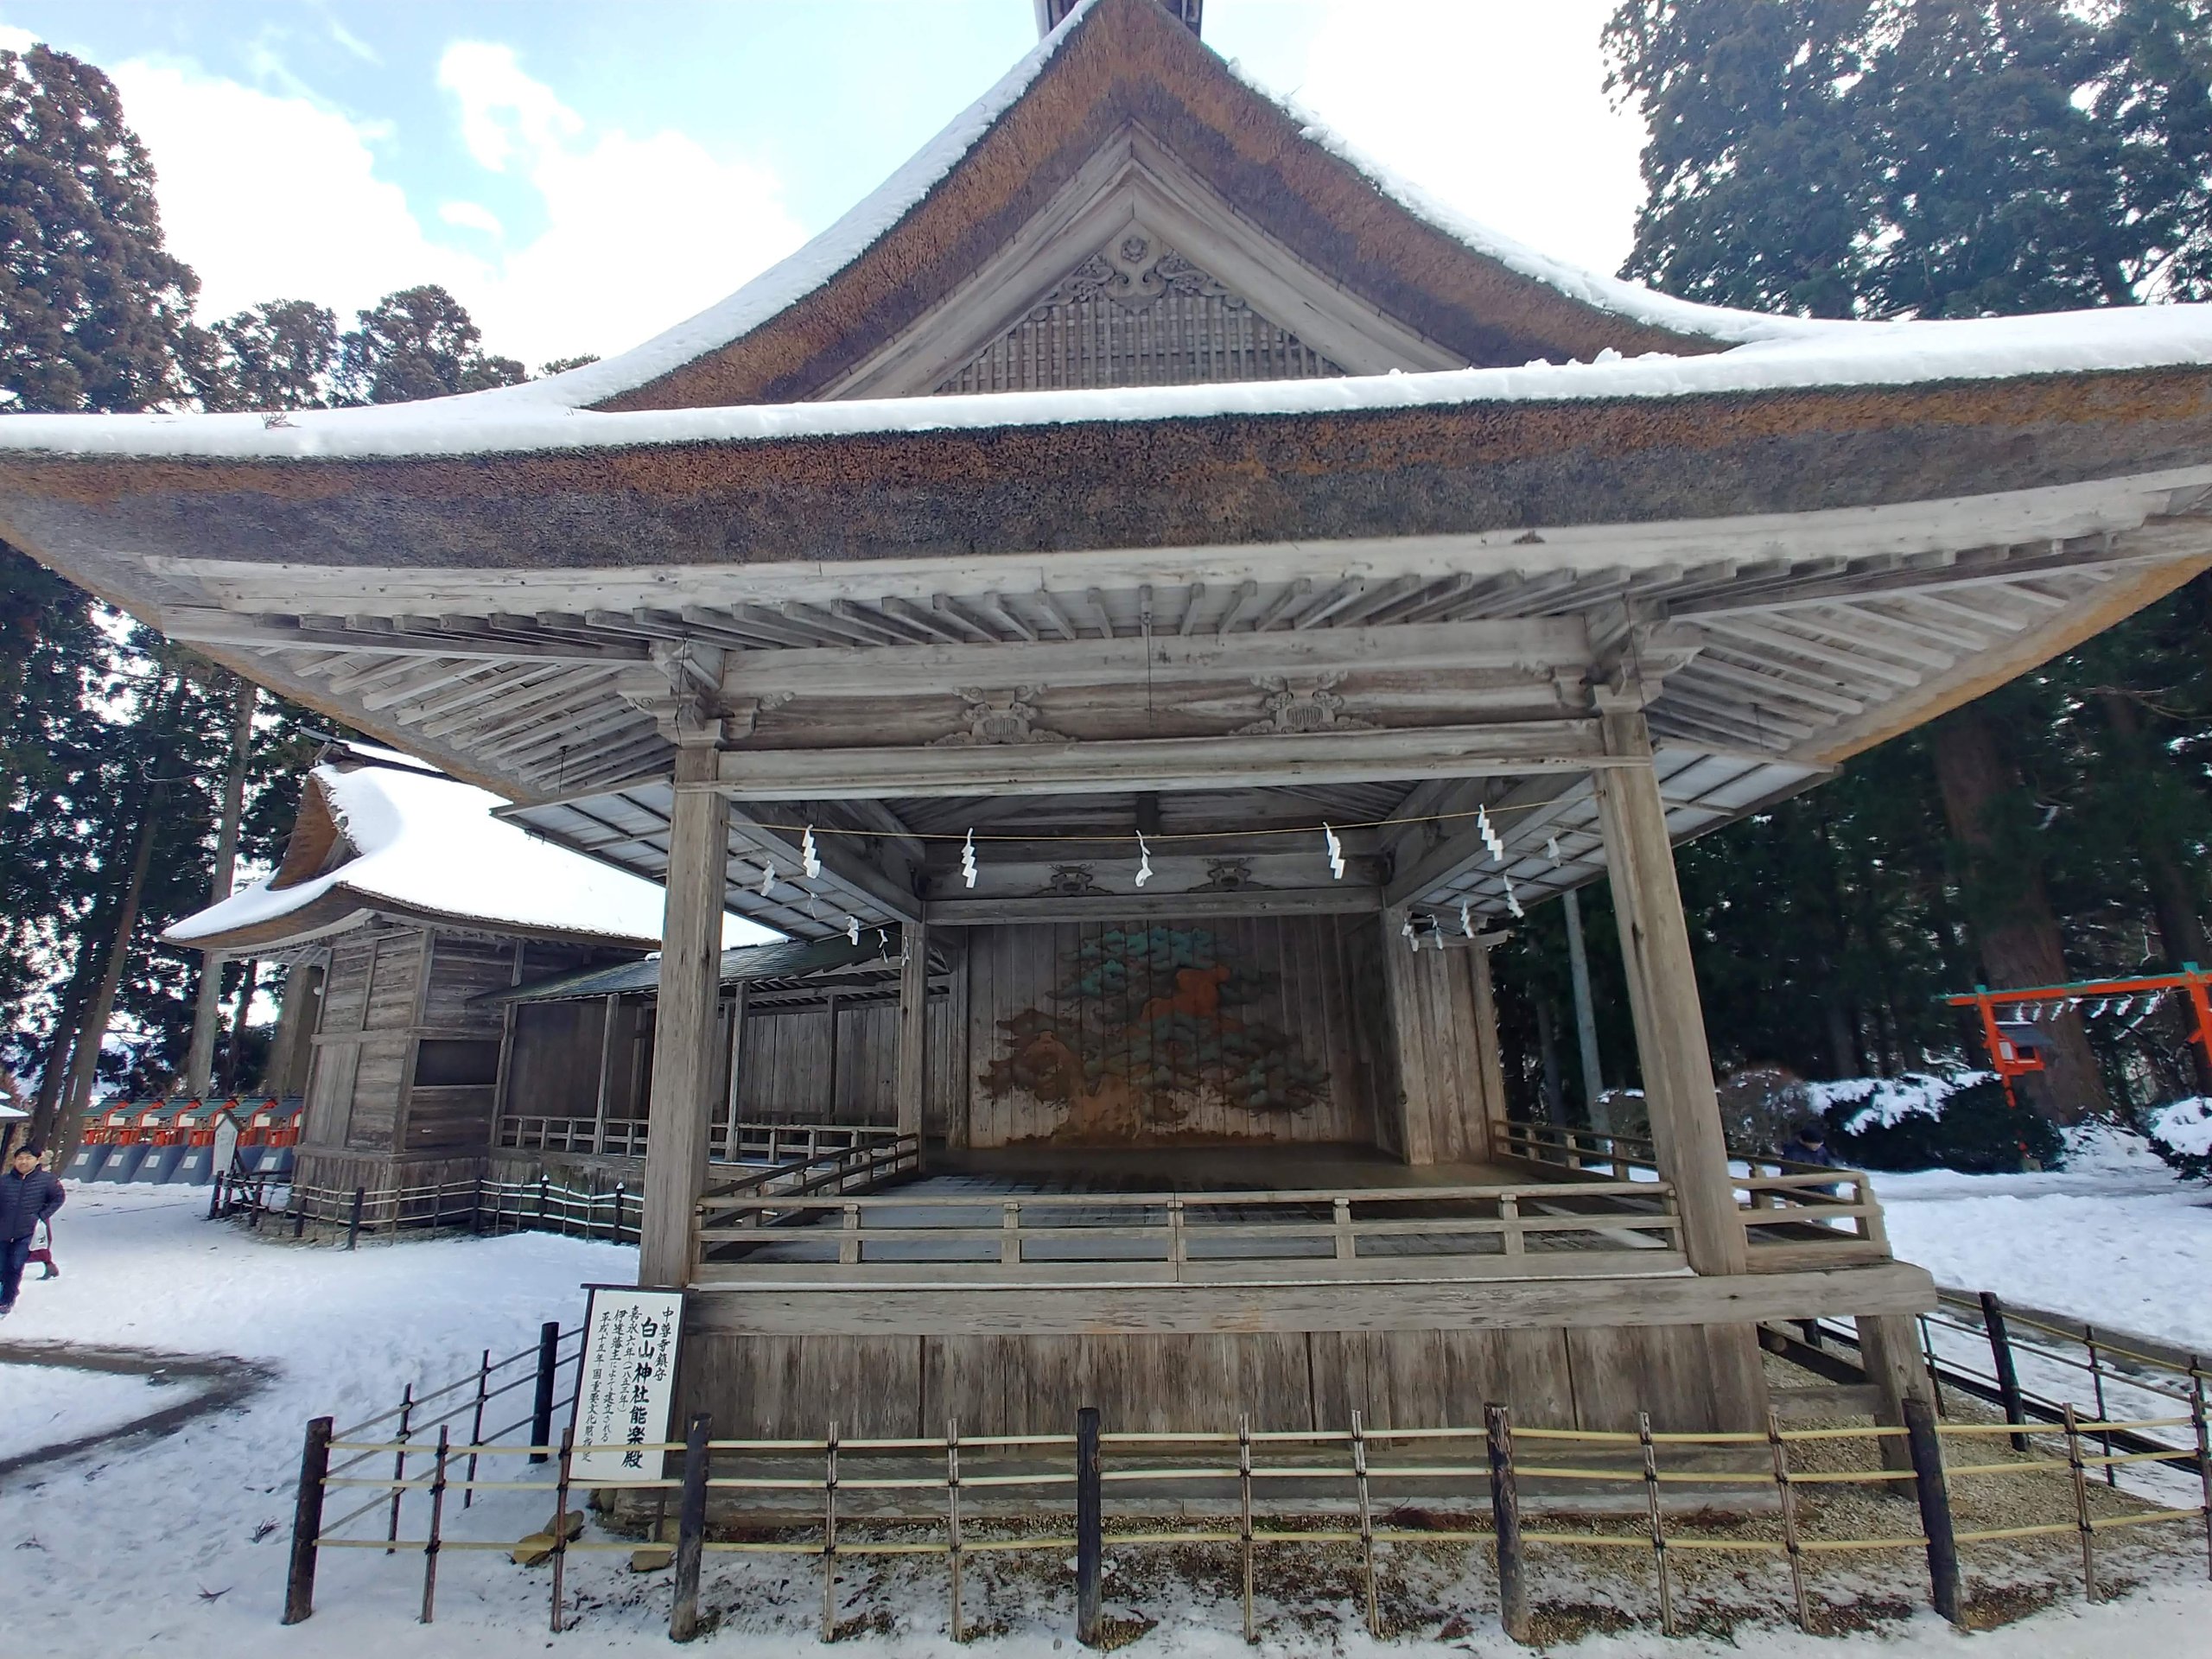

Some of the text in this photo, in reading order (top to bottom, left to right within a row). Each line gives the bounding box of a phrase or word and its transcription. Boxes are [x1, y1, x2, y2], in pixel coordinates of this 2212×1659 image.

[620, 1316, 658, 1470] 白山神社能楽殿
[652, 1306, 675, 1382] 中尊寺鎮守
